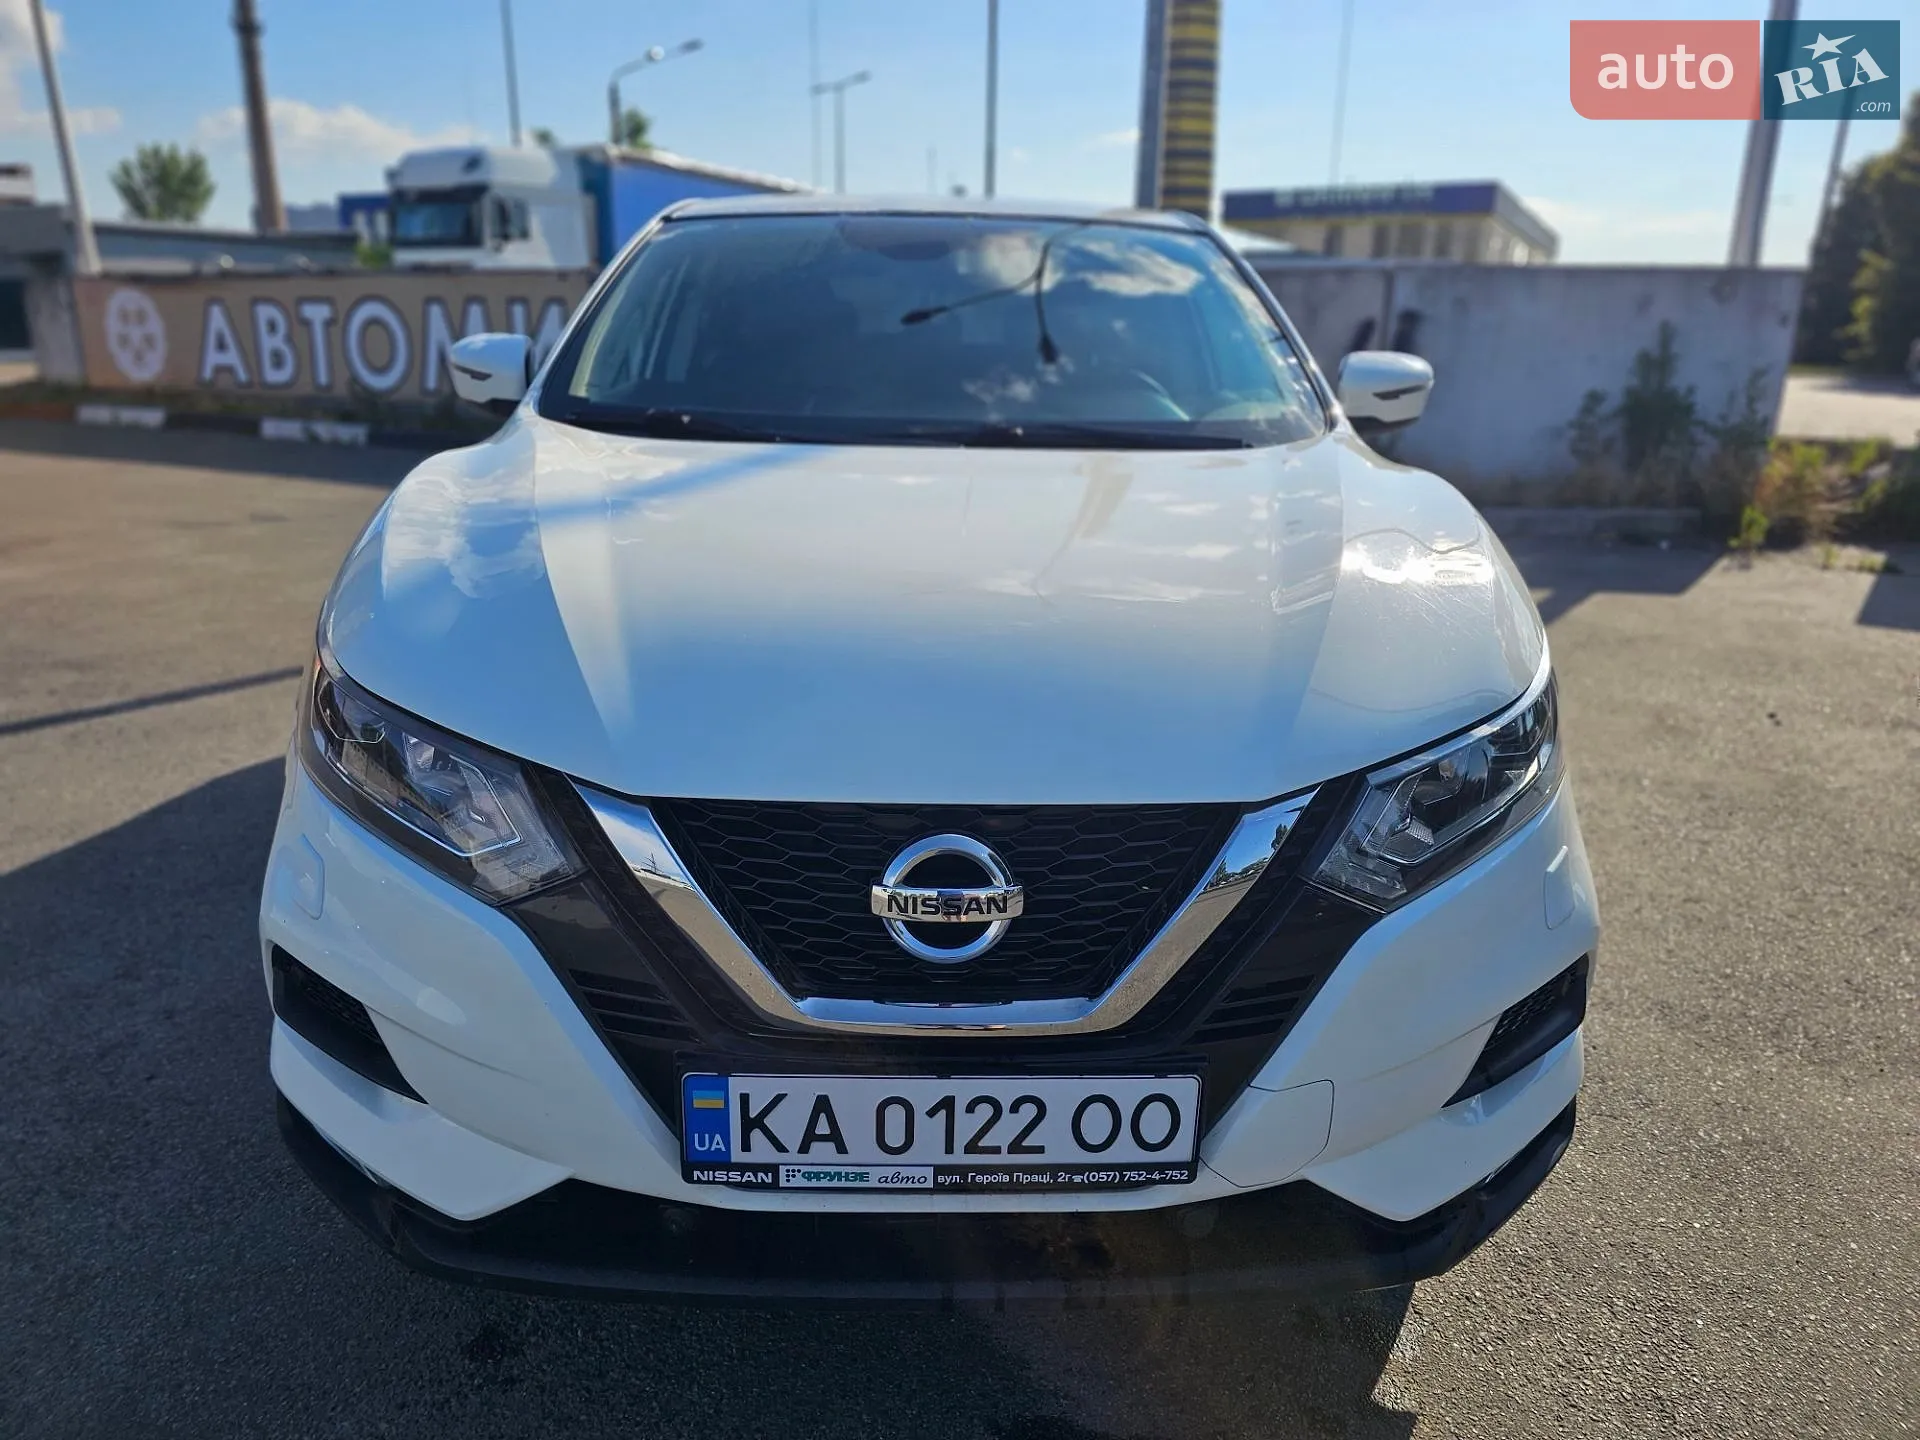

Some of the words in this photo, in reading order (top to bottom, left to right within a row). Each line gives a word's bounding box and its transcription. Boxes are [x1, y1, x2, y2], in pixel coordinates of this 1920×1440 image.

[887, 894, 1008, 915] NISSAN
[738, 1092, 849, 1155] KA
[875, 1094, 1047, 1156] 0122
[1071, 1093, 1182, 1153] OO
[693, 1133, 727, 1152] UA
[693, 1170, 773, 1183] NISSAN
[800, 1171, 870, 1183] ФРУНЗЕ
[878, 1171, 928, 1184] авто
[937, 1173, 964, 1184] вул.
[968, 1172, 1010, 1184] Героїв
[1013, 1172, 1053, 1184] Праці,
[1123, 1169, 1189, 1182] 752-4-752
